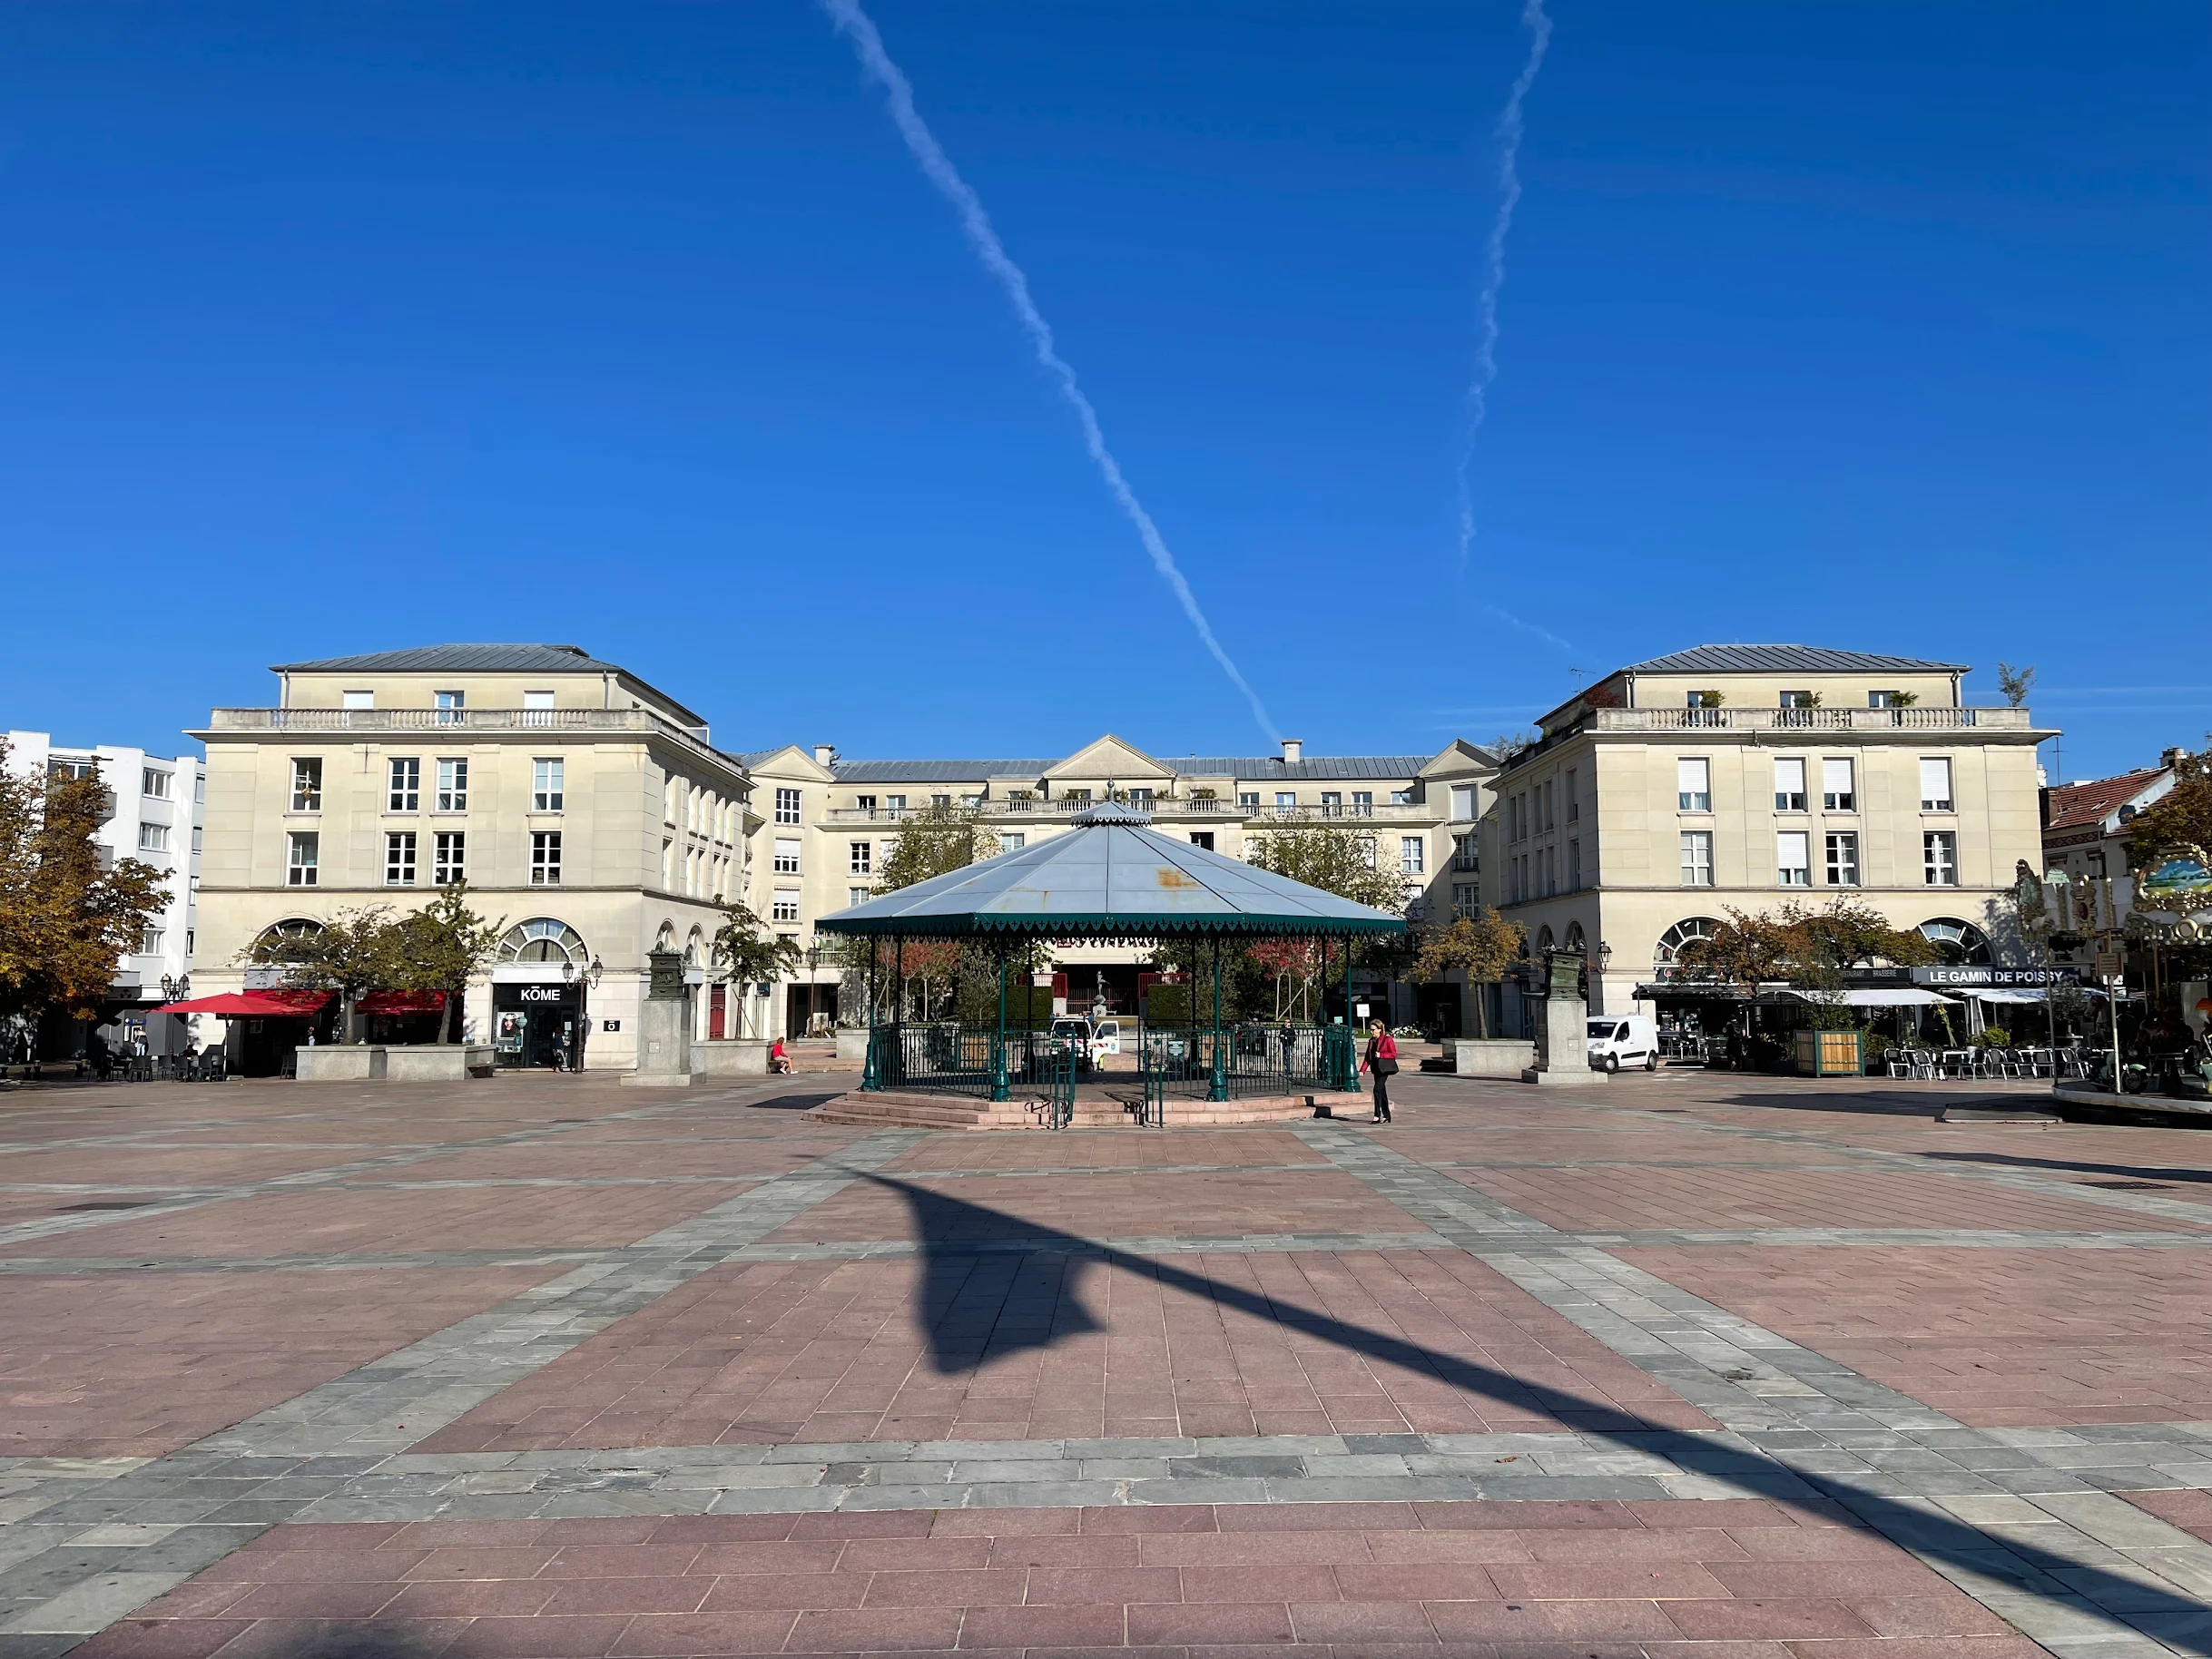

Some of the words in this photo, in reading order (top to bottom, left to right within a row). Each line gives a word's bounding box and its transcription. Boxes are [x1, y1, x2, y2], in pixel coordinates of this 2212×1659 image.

[1873, 969, 1897, 977] BRASSERIE
[1930, 972, 1946, 982] LE
[1949, 971, 1991, 983] GAMIN
[1995, 972, 2012, 982] DE
[2015, 971, 2063, 983] POISSY
